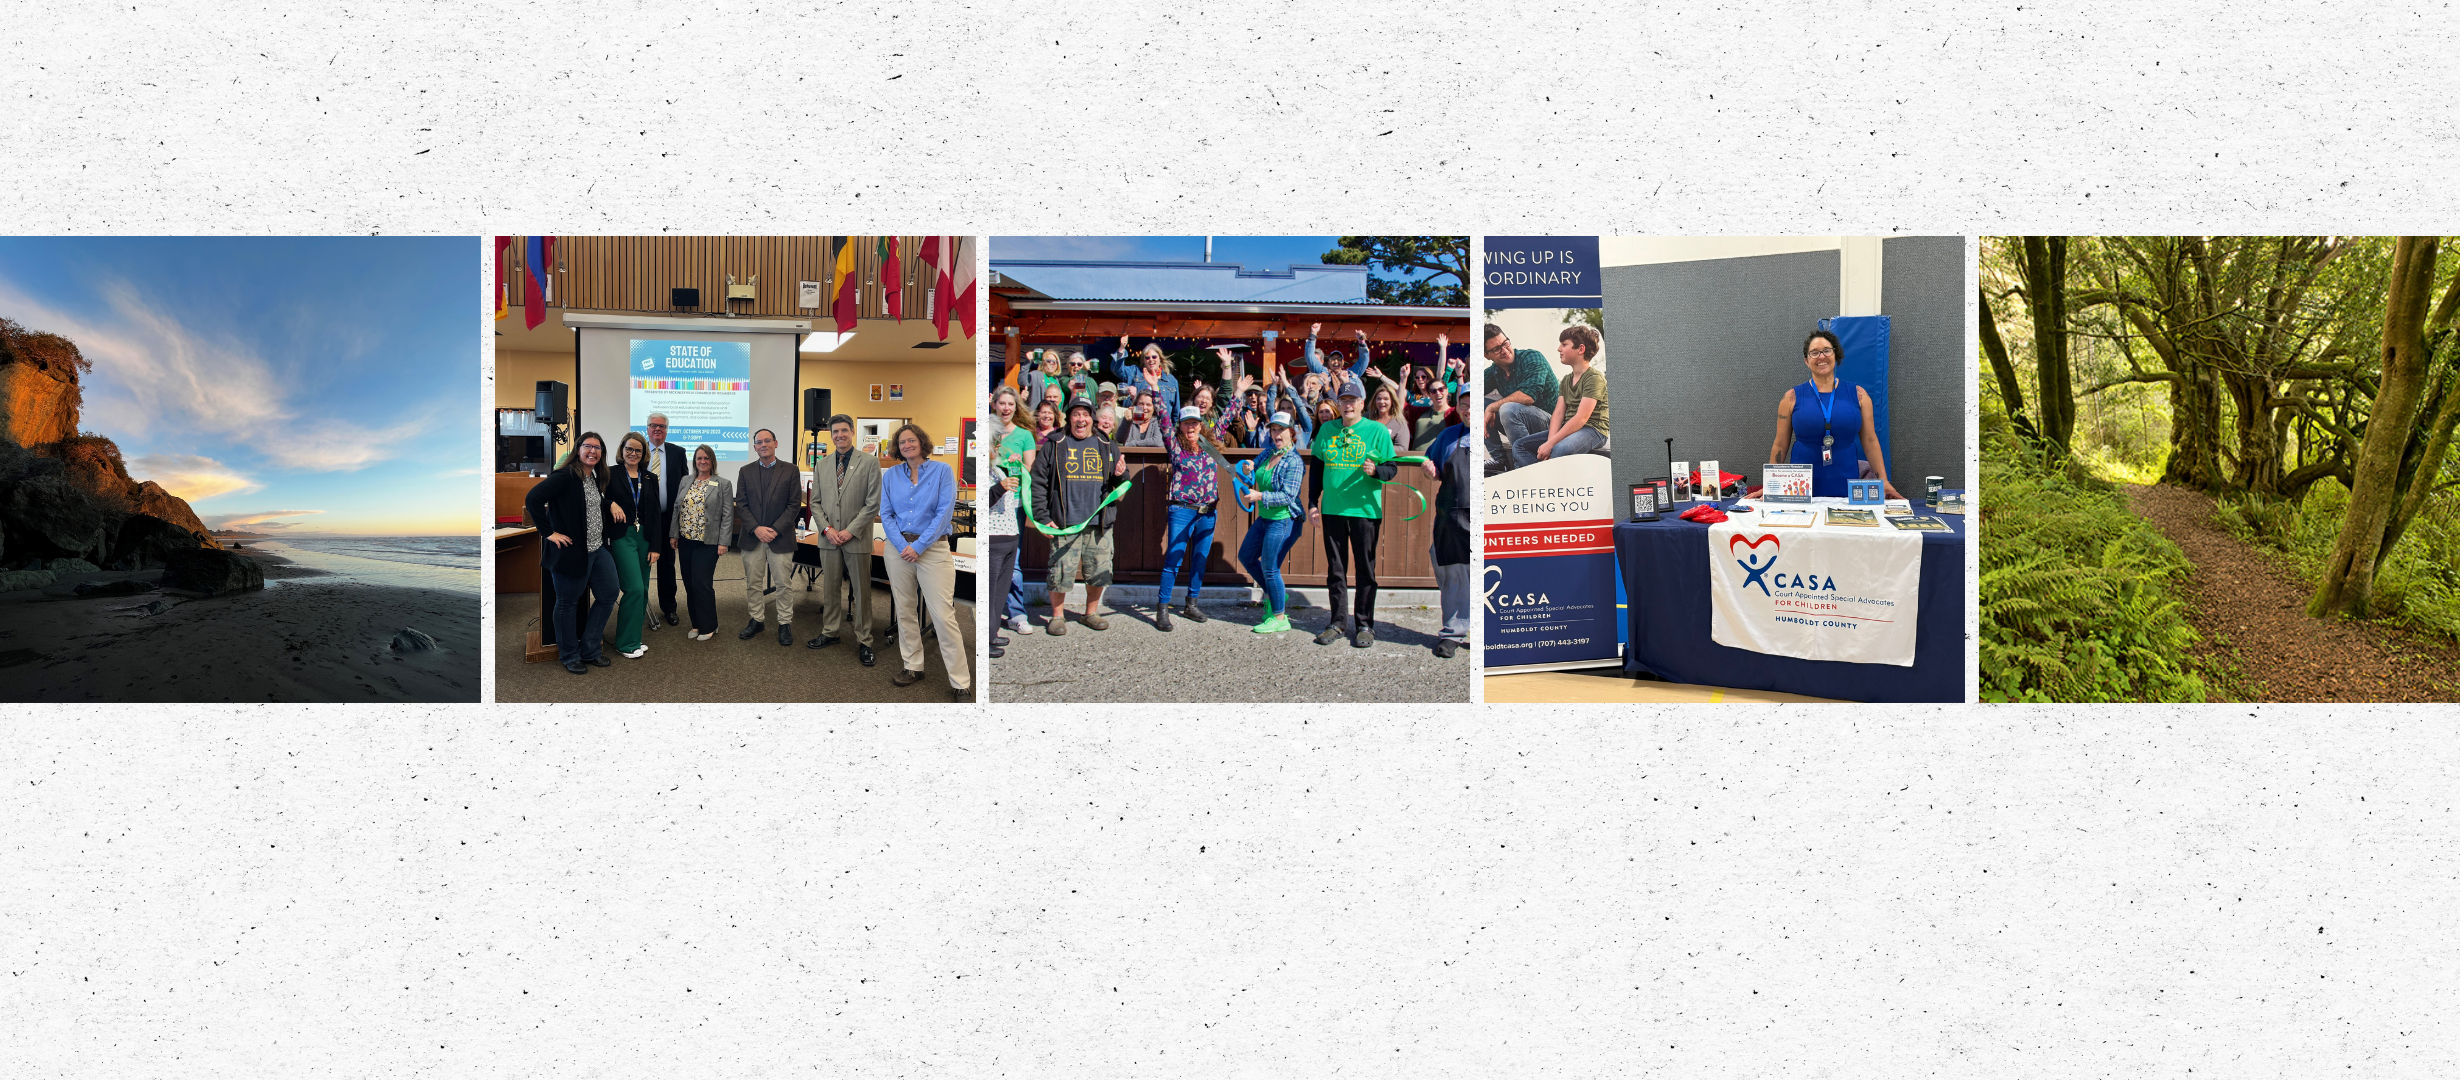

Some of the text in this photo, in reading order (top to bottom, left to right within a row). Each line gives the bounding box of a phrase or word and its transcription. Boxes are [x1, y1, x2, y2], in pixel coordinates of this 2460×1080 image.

[1531, 250, 1554, 265] UP
[1560, 250, 1574, 265] IS
[670, 345, 712, 357] STATE OF
[665, 357, 717, 369] EDUCATION
[1329, 436, 1340, 448] I
[1068, 448, 1078, 460] I
[1492, 486, 1594, 500] A DIFFERENCE
[1491, 501, 1590, 514] BY BEING YOU
[1544, 533, 1596, 545] NEEDED
[1774, 573, 1837, 592] CASA
[1498, 592, 1550, 607] CASA
[1794, 591, 1829, 601] Appointed
[1830, 594, 1856, 603] Special
[1858, 596, 1894, 607] Advocates
[1794, 600, 1838, 610] CHILDREN
[1775, 616, 1858, 630] HUMBOLDT COUNTY
[1484, 642, 1533, 651] boldtcasa.org
[1557, 638, 1590, 646] 443-3197
